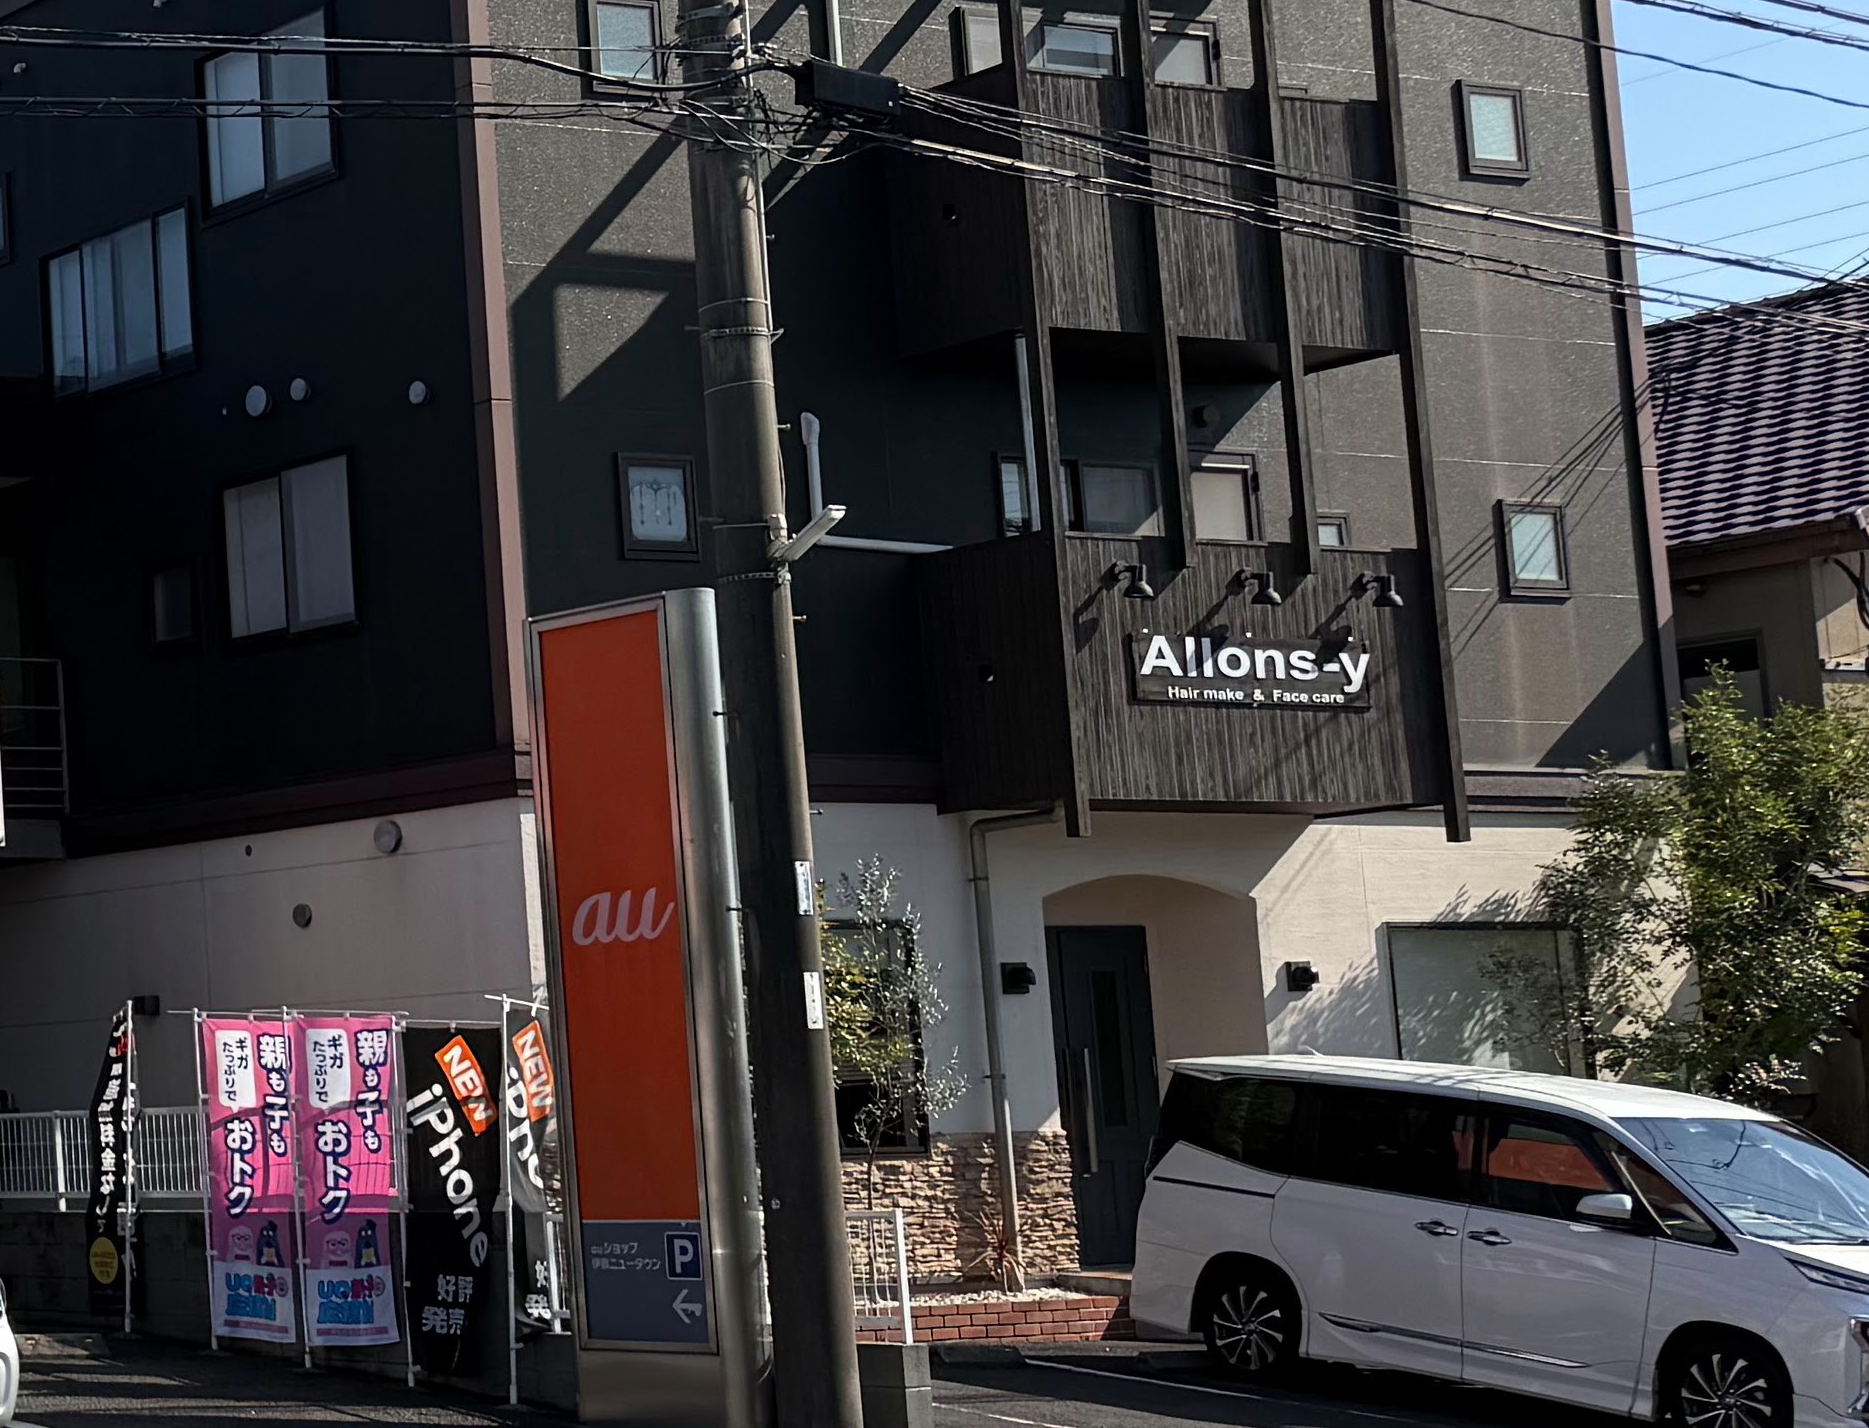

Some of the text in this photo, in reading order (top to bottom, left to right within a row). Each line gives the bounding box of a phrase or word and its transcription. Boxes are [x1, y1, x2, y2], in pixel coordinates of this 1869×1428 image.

[1140, 635, 1370, 693] Allons-y
[1167, 686, 1344, 704] Hair make & Face care
[572, 886, 674, 946] au
[355, 1029, 388, 1152] 親も子も
[443, 1045, 494, 1121] NEW
[516, 1030, 553, 1107] NEW
[225, 1119, 255, 1217] おトク
[316, 1121, 351, 1223] おトク
[406, 1083, 489, 1268] iPhone
[673, 1238, 694, 1274] P
